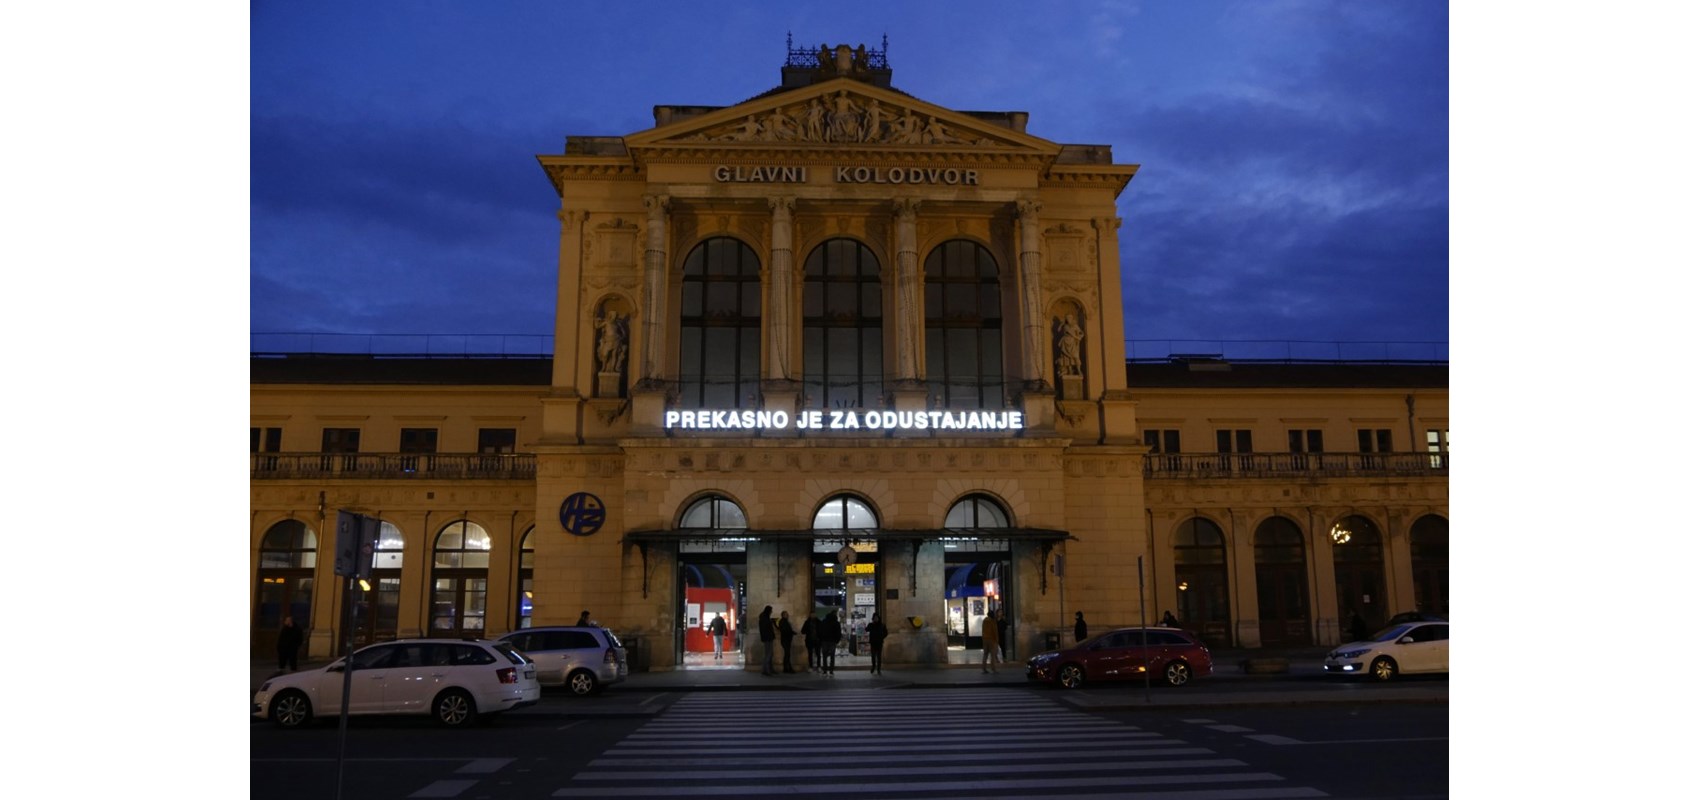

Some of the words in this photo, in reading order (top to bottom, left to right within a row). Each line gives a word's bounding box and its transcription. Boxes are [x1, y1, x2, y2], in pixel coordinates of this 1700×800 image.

[714, 166, 807, 183] GLAVNI
[836, 167, 979, 185] KOLODVOR
[665, 410, 789, 429] PREKASNO
[796, 411, 823, 429] JE
[830, 411, 859, 429] ZA
[864, 411, 1023, 430] ODUSTAJANJE
